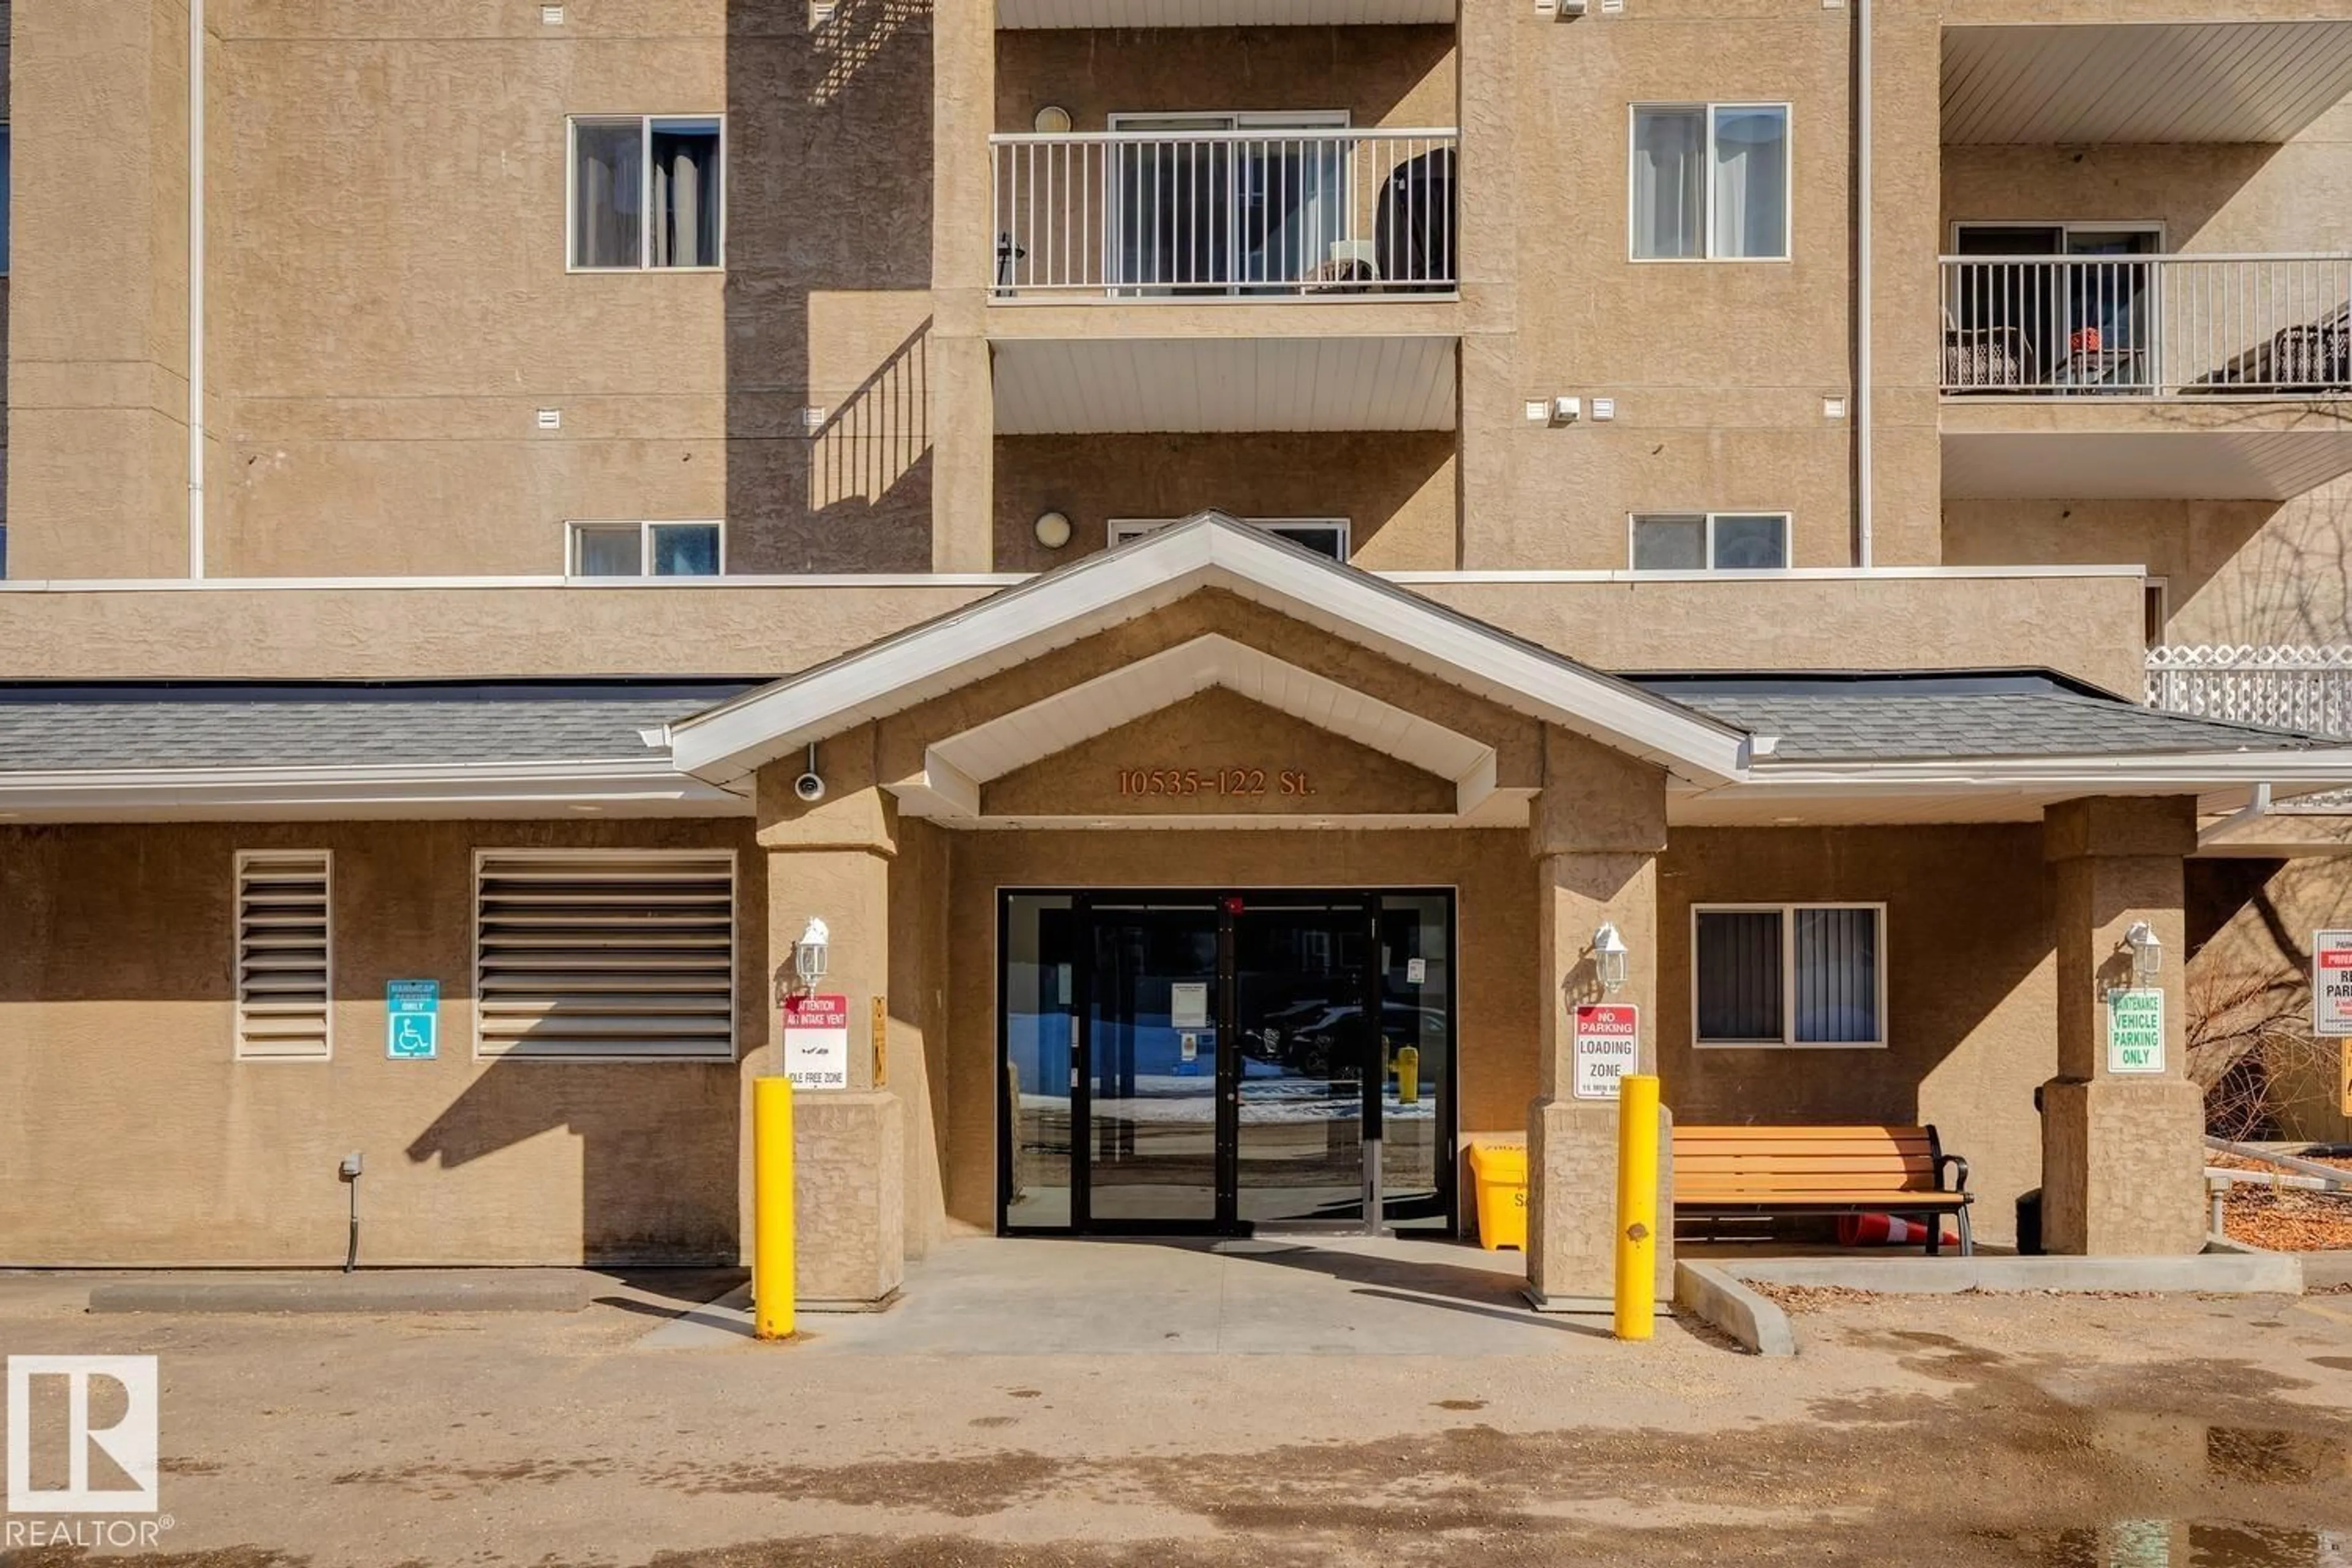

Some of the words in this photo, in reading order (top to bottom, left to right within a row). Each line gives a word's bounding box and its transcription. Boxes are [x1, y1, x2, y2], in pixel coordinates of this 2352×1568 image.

[1119, 769, 1265, 796] 10535-122
[1279, 770, 1317, 796] St.
[2327, 985, 2352, 997] PAR
[798, 1000, 835, 1011] ATTENTION
[801, 1014, 824, 1025] INTAKE
[827, 1014, 845, 1025] VENT
[1598, 1013, 1616, 1022] NO
[2115, 1014, 2157, 1029] VEHICLE
[1580, 1023, 1632, 1033] PARKING
[2114, 1032, 2158, 1047] PARKING
[1580, 1041, 1632, 1054] LOADING
[2123, 1049, 2149, 1064] ONLY
[1590, 1063, 1621, 1077] ZONE
[788, 1072, 803, 1083] DLE
[805, 1072, 822, 1083] FREE
[824, 1072, 843, 1083] ZONE
